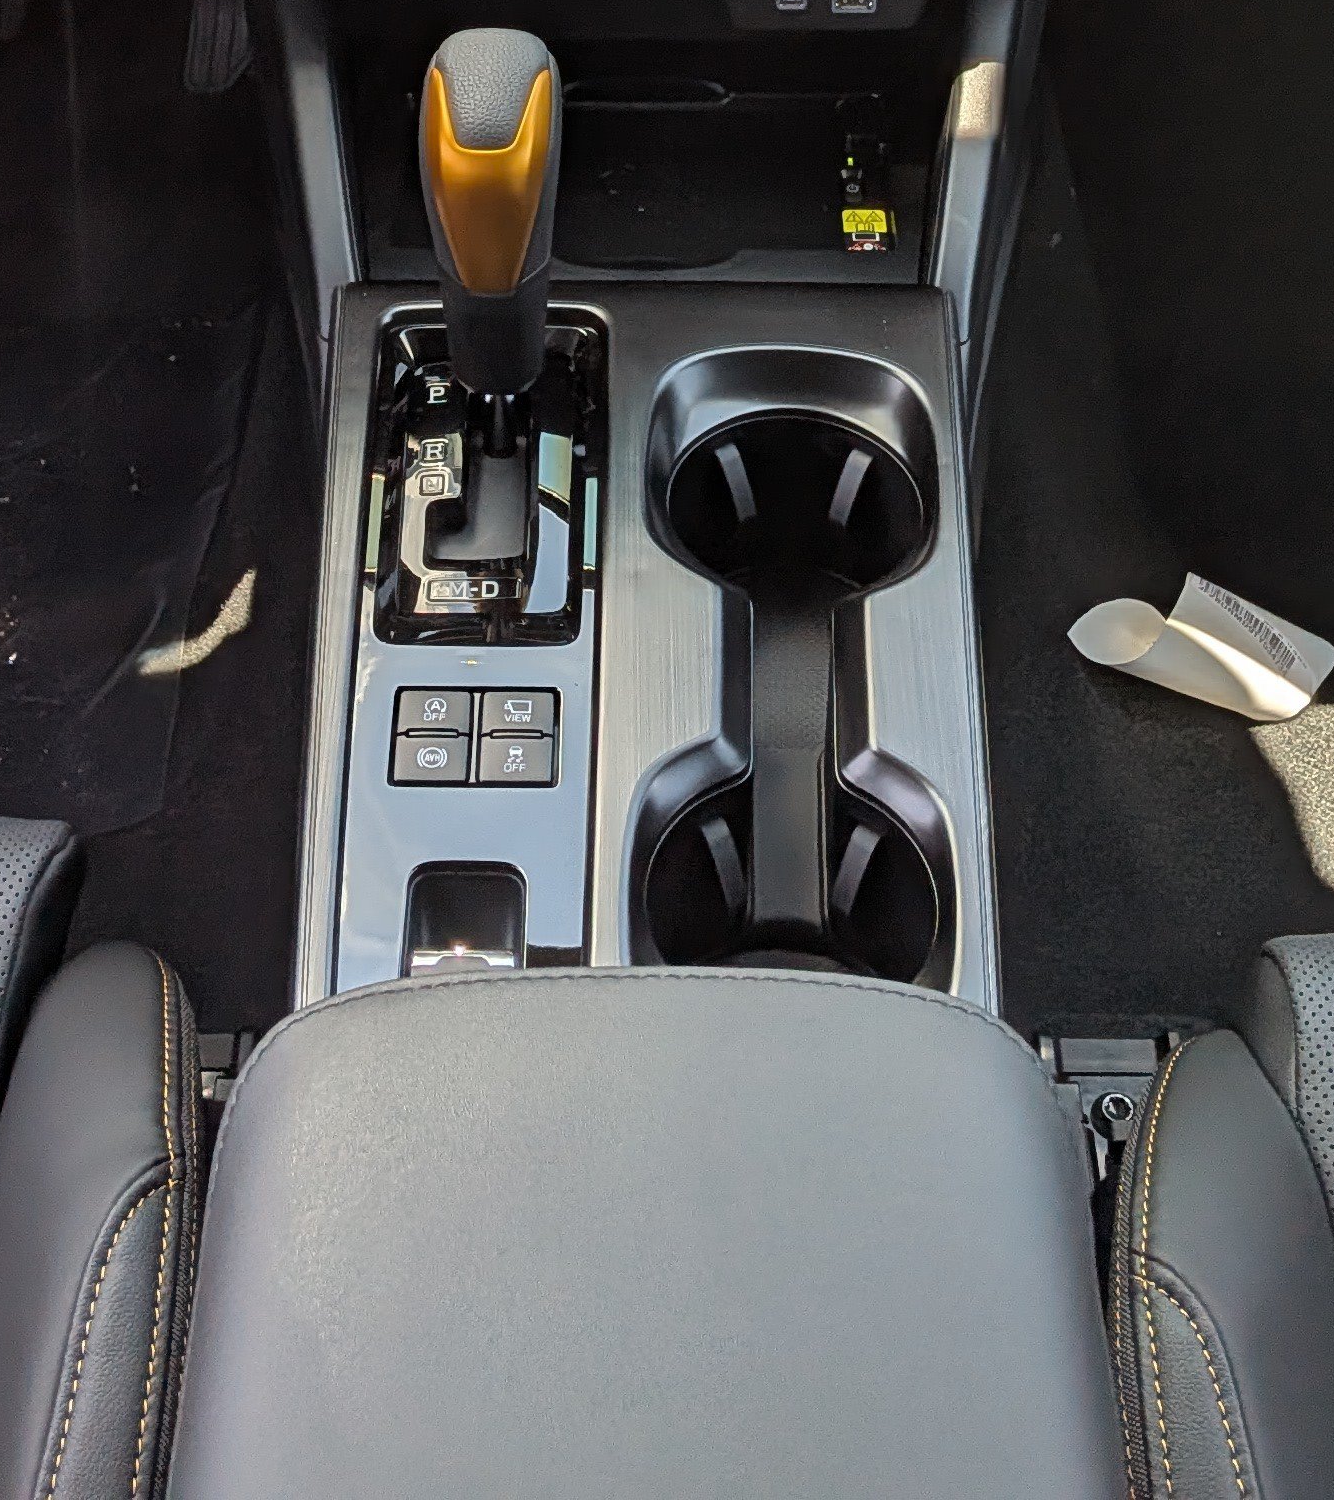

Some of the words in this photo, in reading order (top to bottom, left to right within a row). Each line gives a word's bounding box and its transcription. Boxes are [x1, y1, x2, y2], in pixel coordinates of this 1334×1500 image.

[423, 713, 446, 721] OFF
[504, 714, 532, 723] VIEW
[424, 753, 440, 762] AVH
[503, 763, 526, 773] OFF
